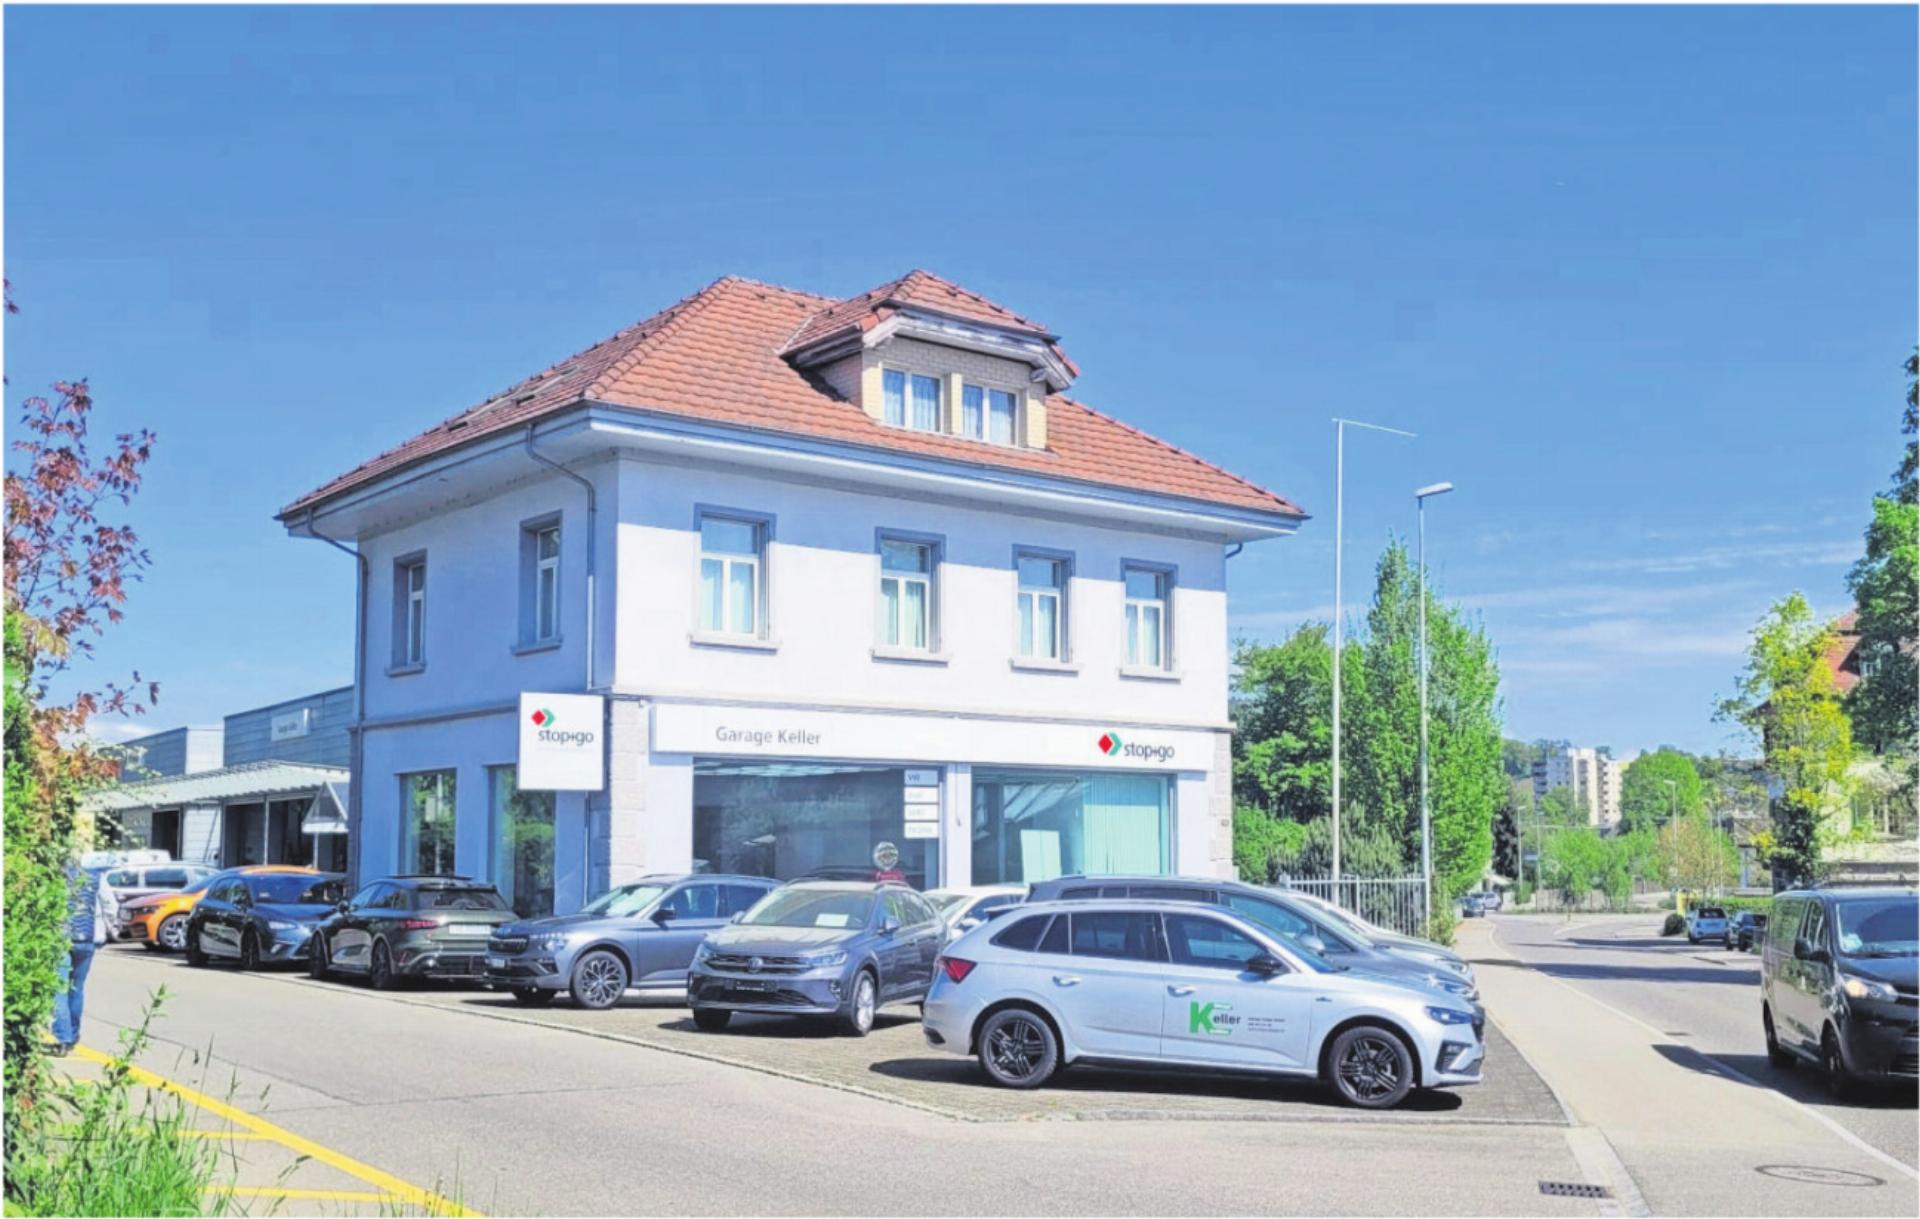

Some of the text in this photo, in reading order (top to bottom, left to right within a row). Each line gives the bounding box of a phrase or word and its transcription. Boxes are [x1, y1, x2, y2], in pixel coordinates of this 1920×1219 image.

[538, 729, 594, 747] stop+go
[715, 726, 821, 746] Garage Keller
[1123, 741, 1175, 762] stop+go
